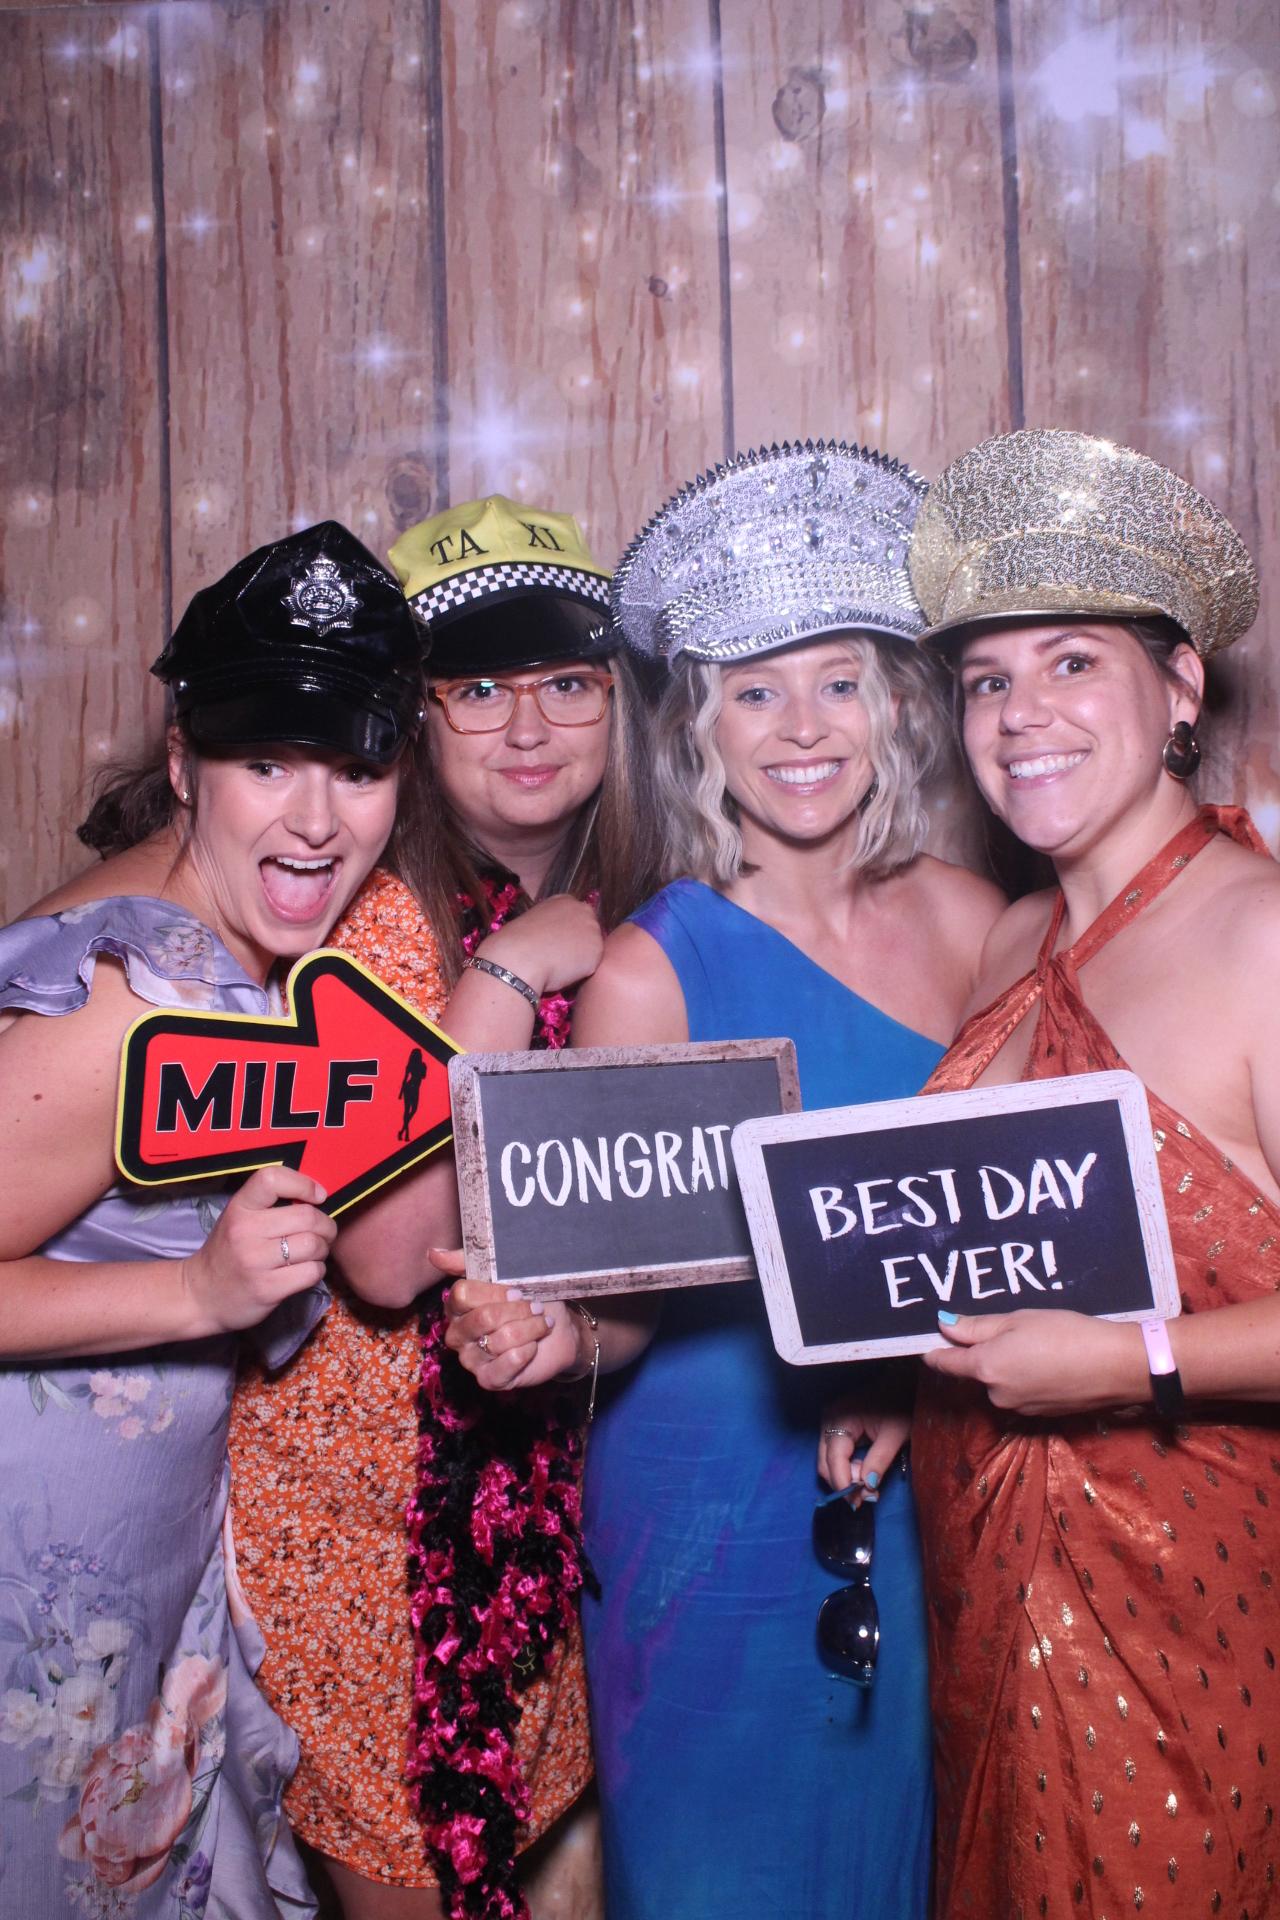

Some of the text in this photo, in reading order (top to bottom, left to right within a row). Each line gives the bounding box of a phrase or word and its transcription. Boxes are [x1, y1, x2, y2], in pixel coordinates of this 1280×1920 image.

[155, 1059, 379, 1133] MILF
[501, 1125, 731, 1208] CONGRAT
[808, 1152, 1097, 1241] BEST DAY
[880, 1240, 1064, 1309] EVER!
